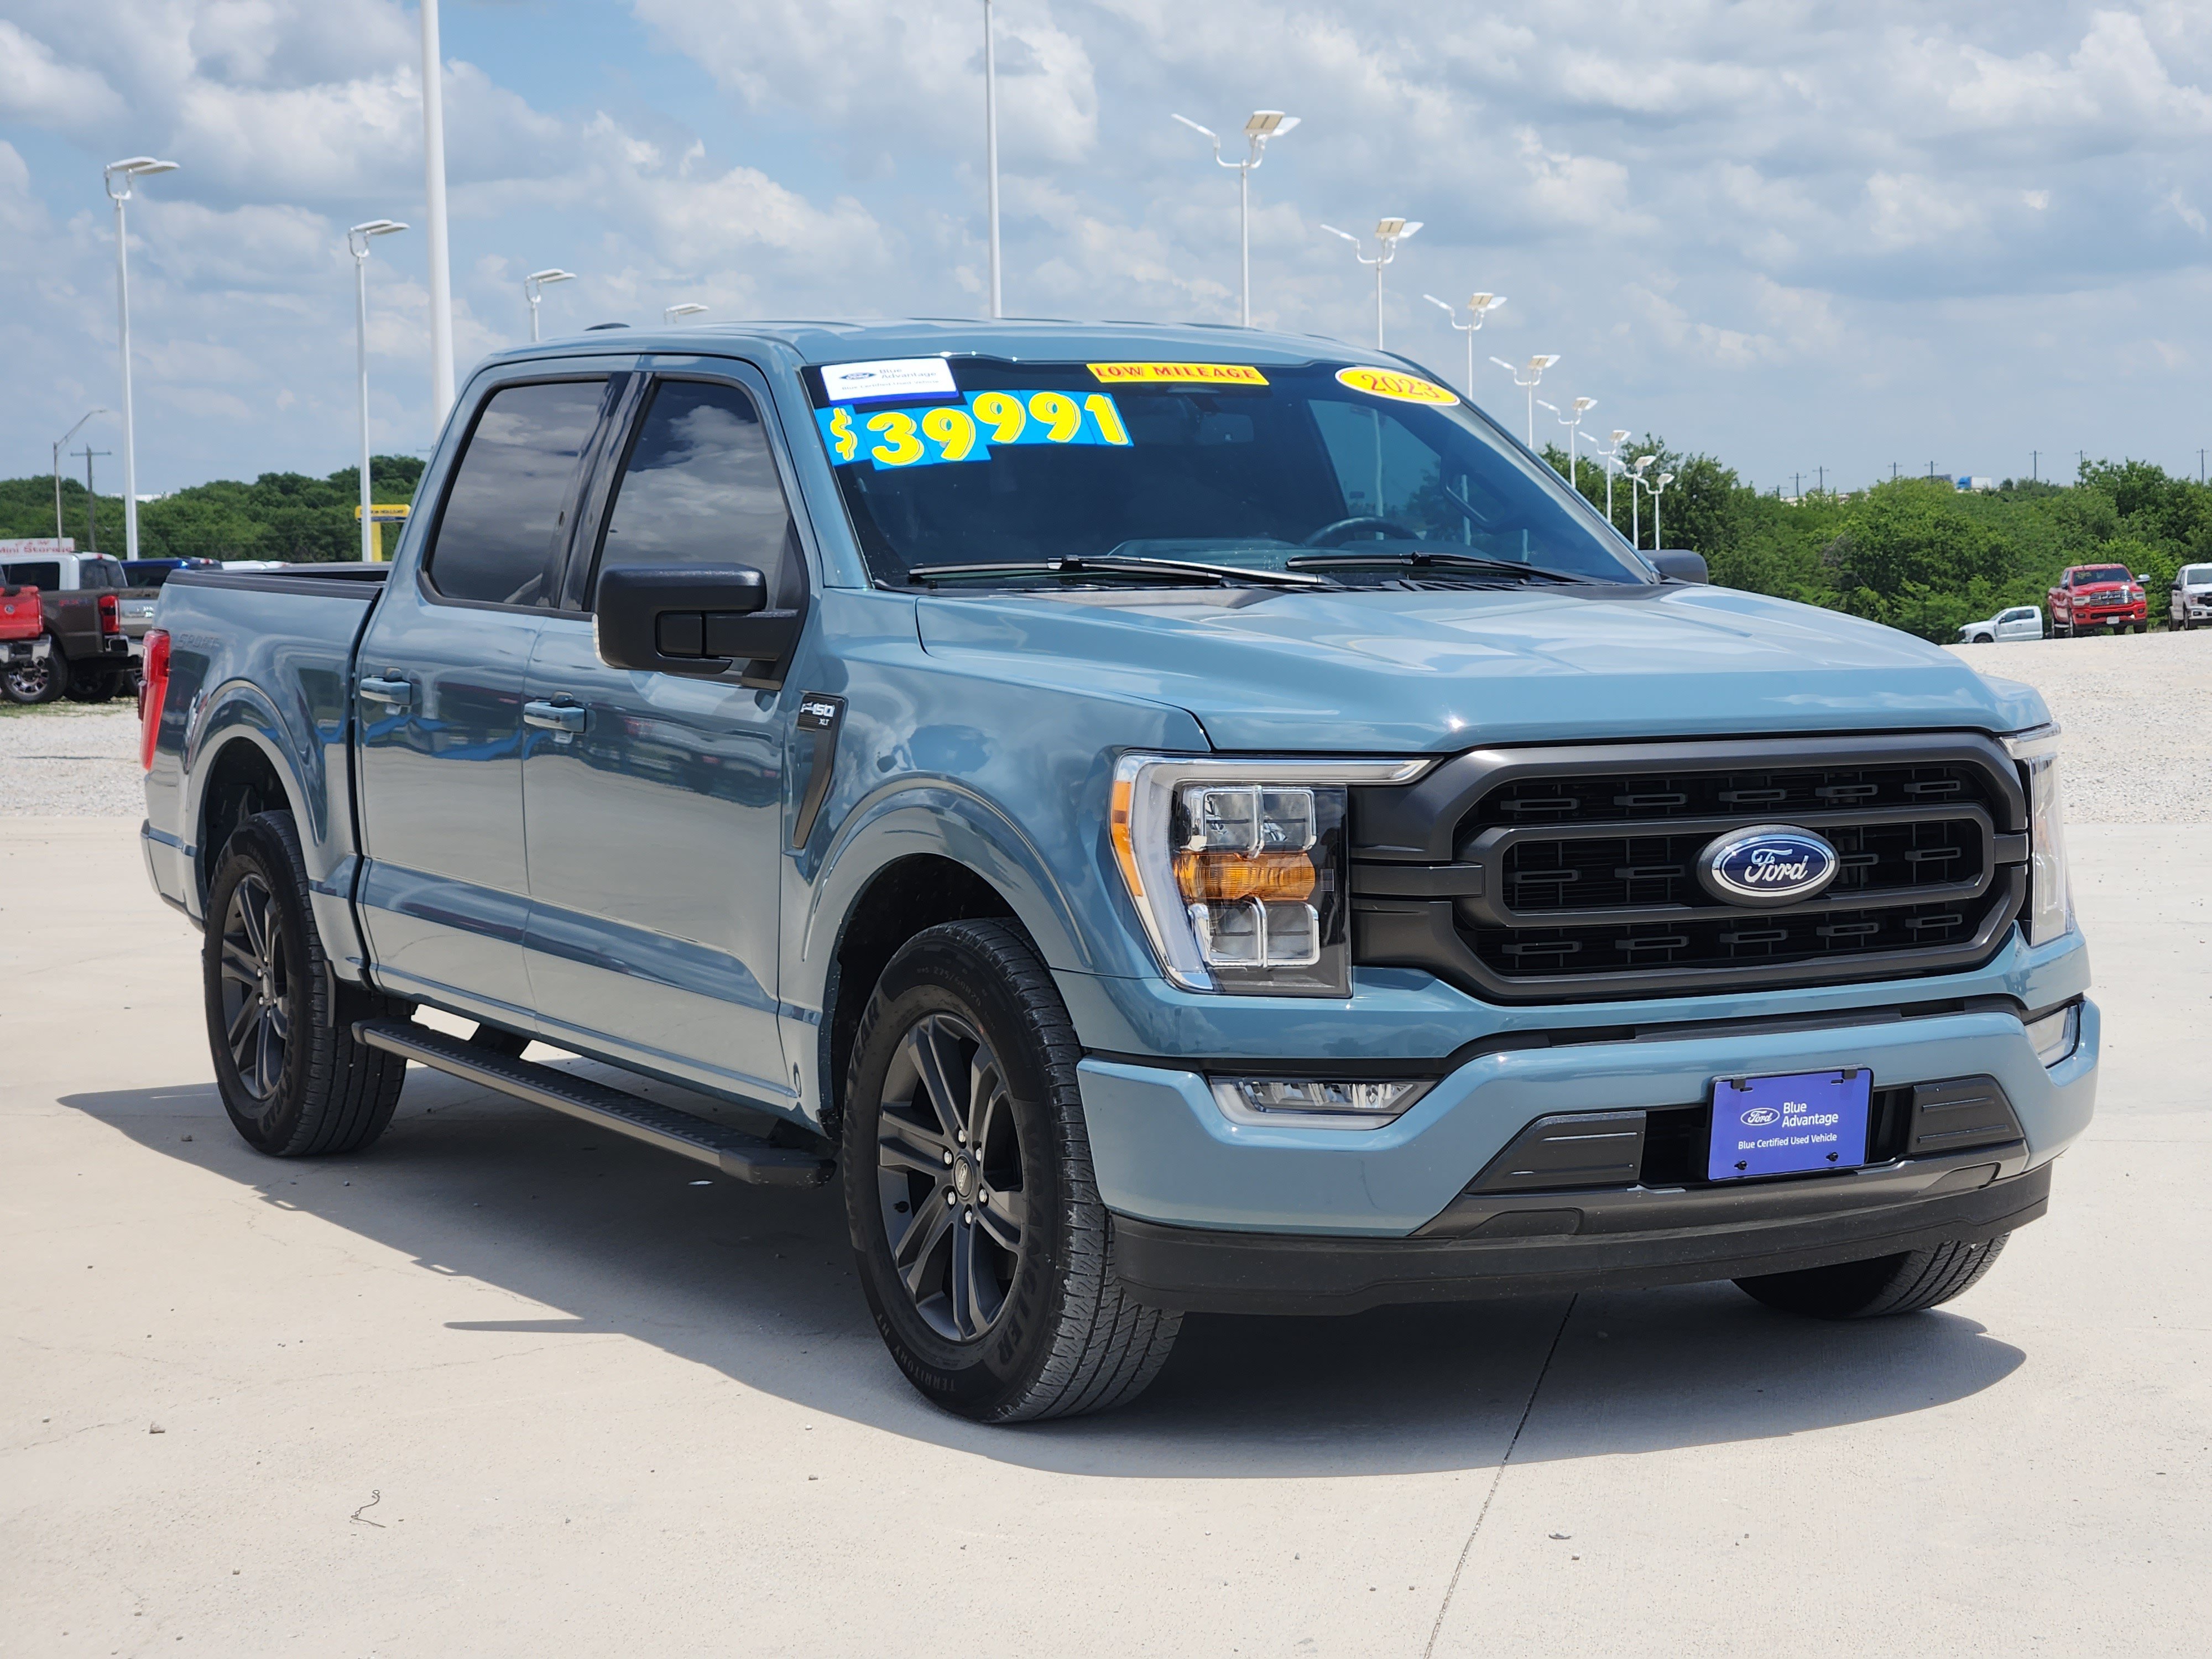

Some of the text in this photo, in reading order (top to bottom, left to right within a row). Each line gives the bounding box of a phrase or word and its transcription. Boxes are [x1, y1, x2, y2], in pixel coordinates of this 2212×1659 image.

[1095, 366, 1256, 380] LOW MILEAGE
[1361, 374, 1439, 399] 2023
[175, 633, 220, 649] SPORT
[1744, 848, 1809, 883] Ford
[1783, 1102, 1807, 1113] Blue
[1747, 1110, 1773, 1123] Ford
[1782, 1113, 1839, 1128] Advantage
[1738, 1133, 1837, 1150] Blue Certified Used Vehicle
